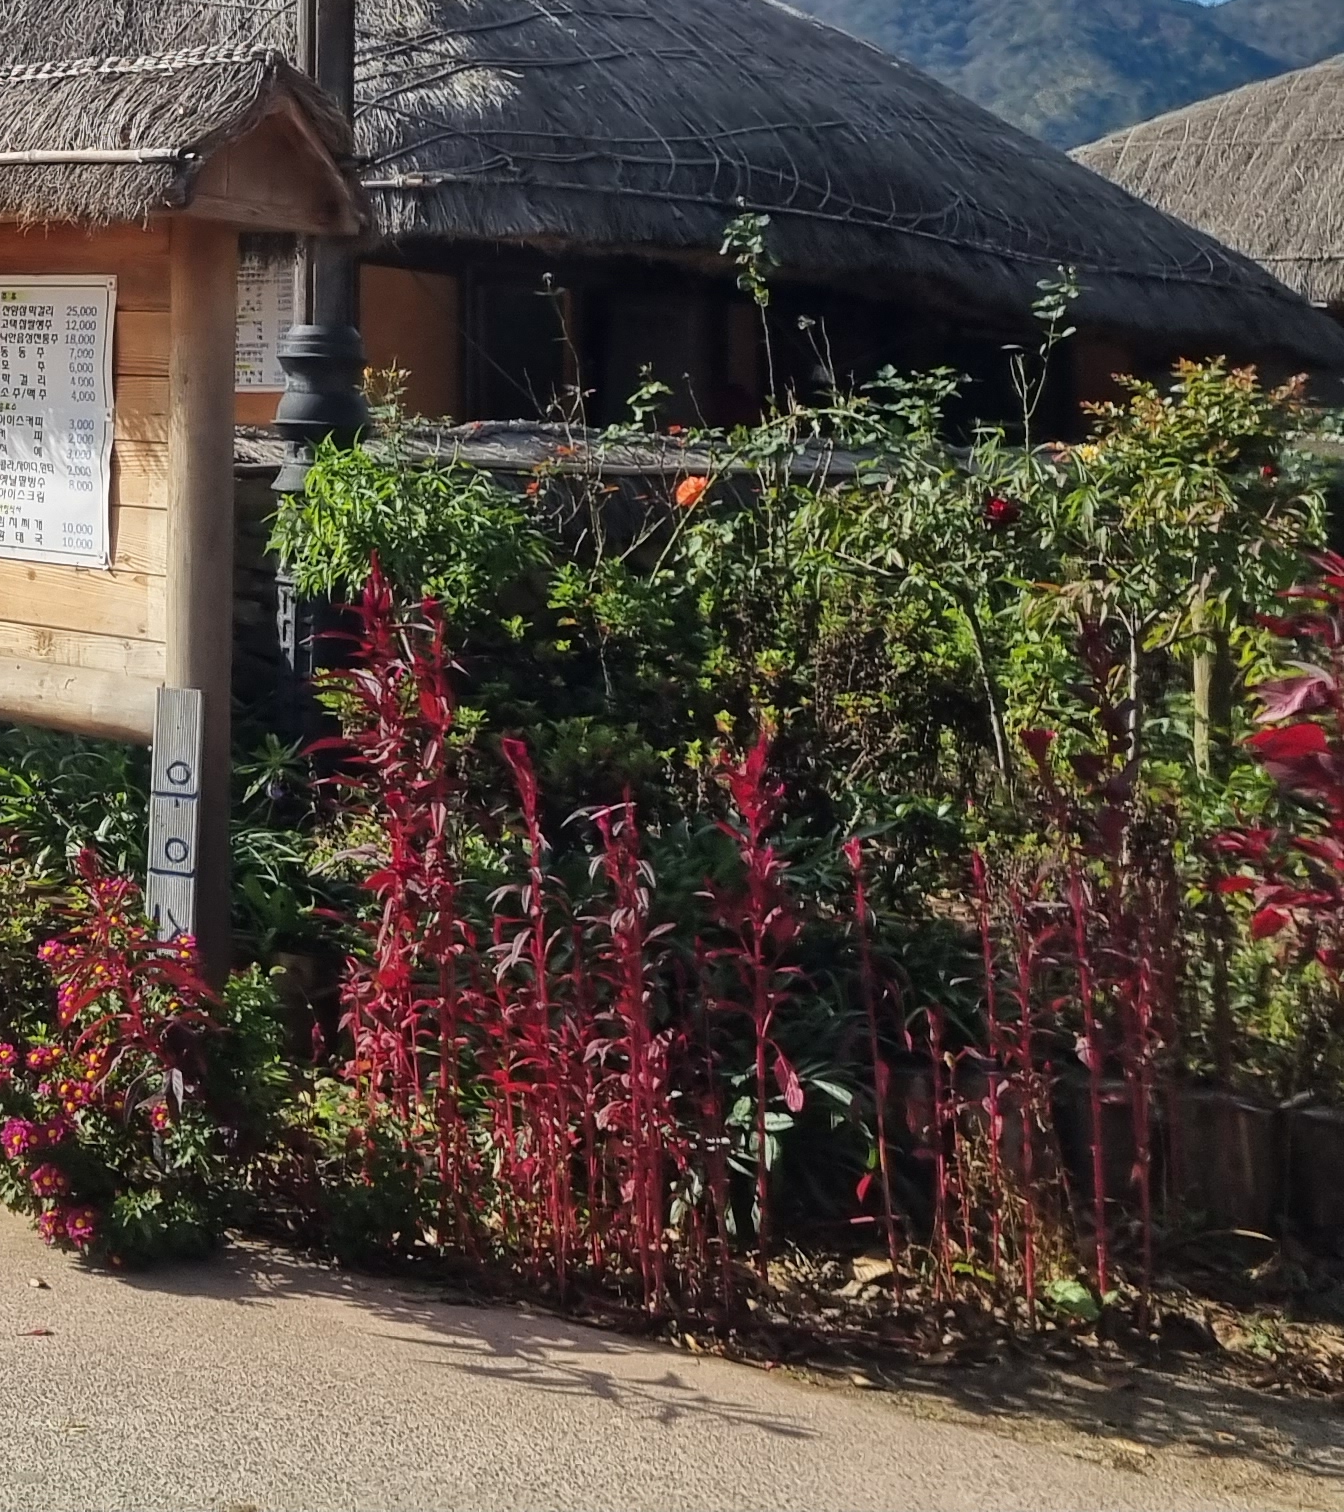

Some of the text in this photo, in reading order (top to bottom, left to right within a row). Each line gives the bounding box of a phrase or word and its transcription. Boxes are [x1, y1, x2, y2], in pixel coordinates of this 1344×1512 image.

[66, 306, 97, 317] 25,000
[66, 320, 96, 331] 12,000
[65, 334, 95, 345] 18,000
[70, 349, 94, 359] 7,000
[69, 363, 93, 373] 6,000
[71, 391, 96, 402] 4,000
[70, 419, 94, 430] 3,000
[68, 434, 93, 445] 2,000
[66, 450, 91, 460] 3,000
[67, 465, 91, 476] 2,000
[62, 523, 93, 535] 10,000
[62, 537, 93, 549] 10,000
